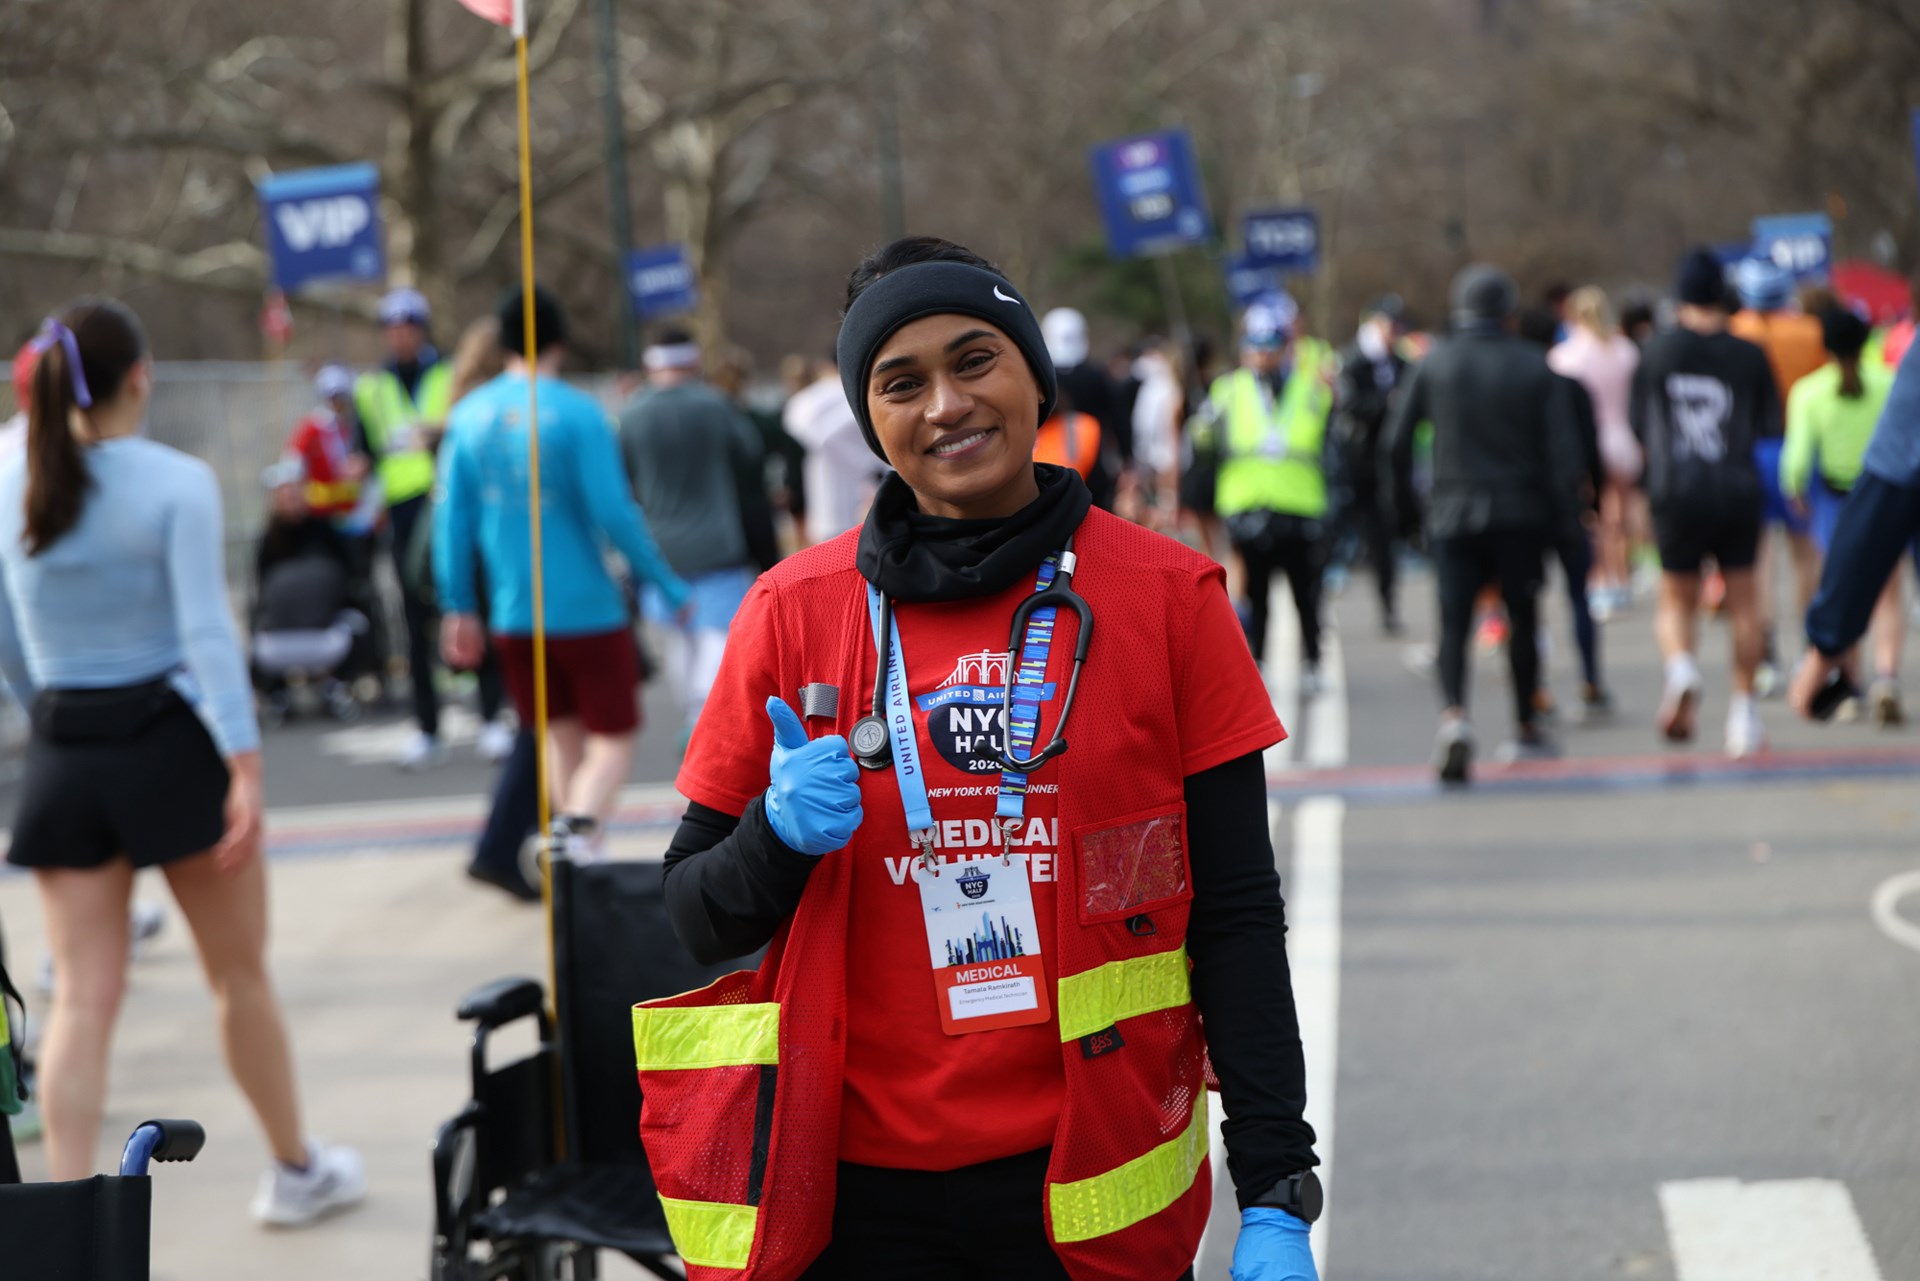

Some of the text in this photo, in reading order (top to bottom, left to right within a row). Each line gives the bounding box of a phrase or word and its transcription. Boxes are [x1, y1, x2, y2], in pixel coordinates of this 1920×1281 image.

[275, 194, 370, 252] VIP
[928, 690, 971, 705] UNITED
[895, 714, 914, 776] UNITED
[955, 735, 1006, 753] HL
[928, 787, 951, 798] NEW
[954, 786, 983, 797] YORK
[1024, 784, 1058, 794] UNNER
[911, 817, 1058, 849] MEDICA
[965, 881, 984, 890] NYC
[956, 963, 1023, 983] MEDICAL
